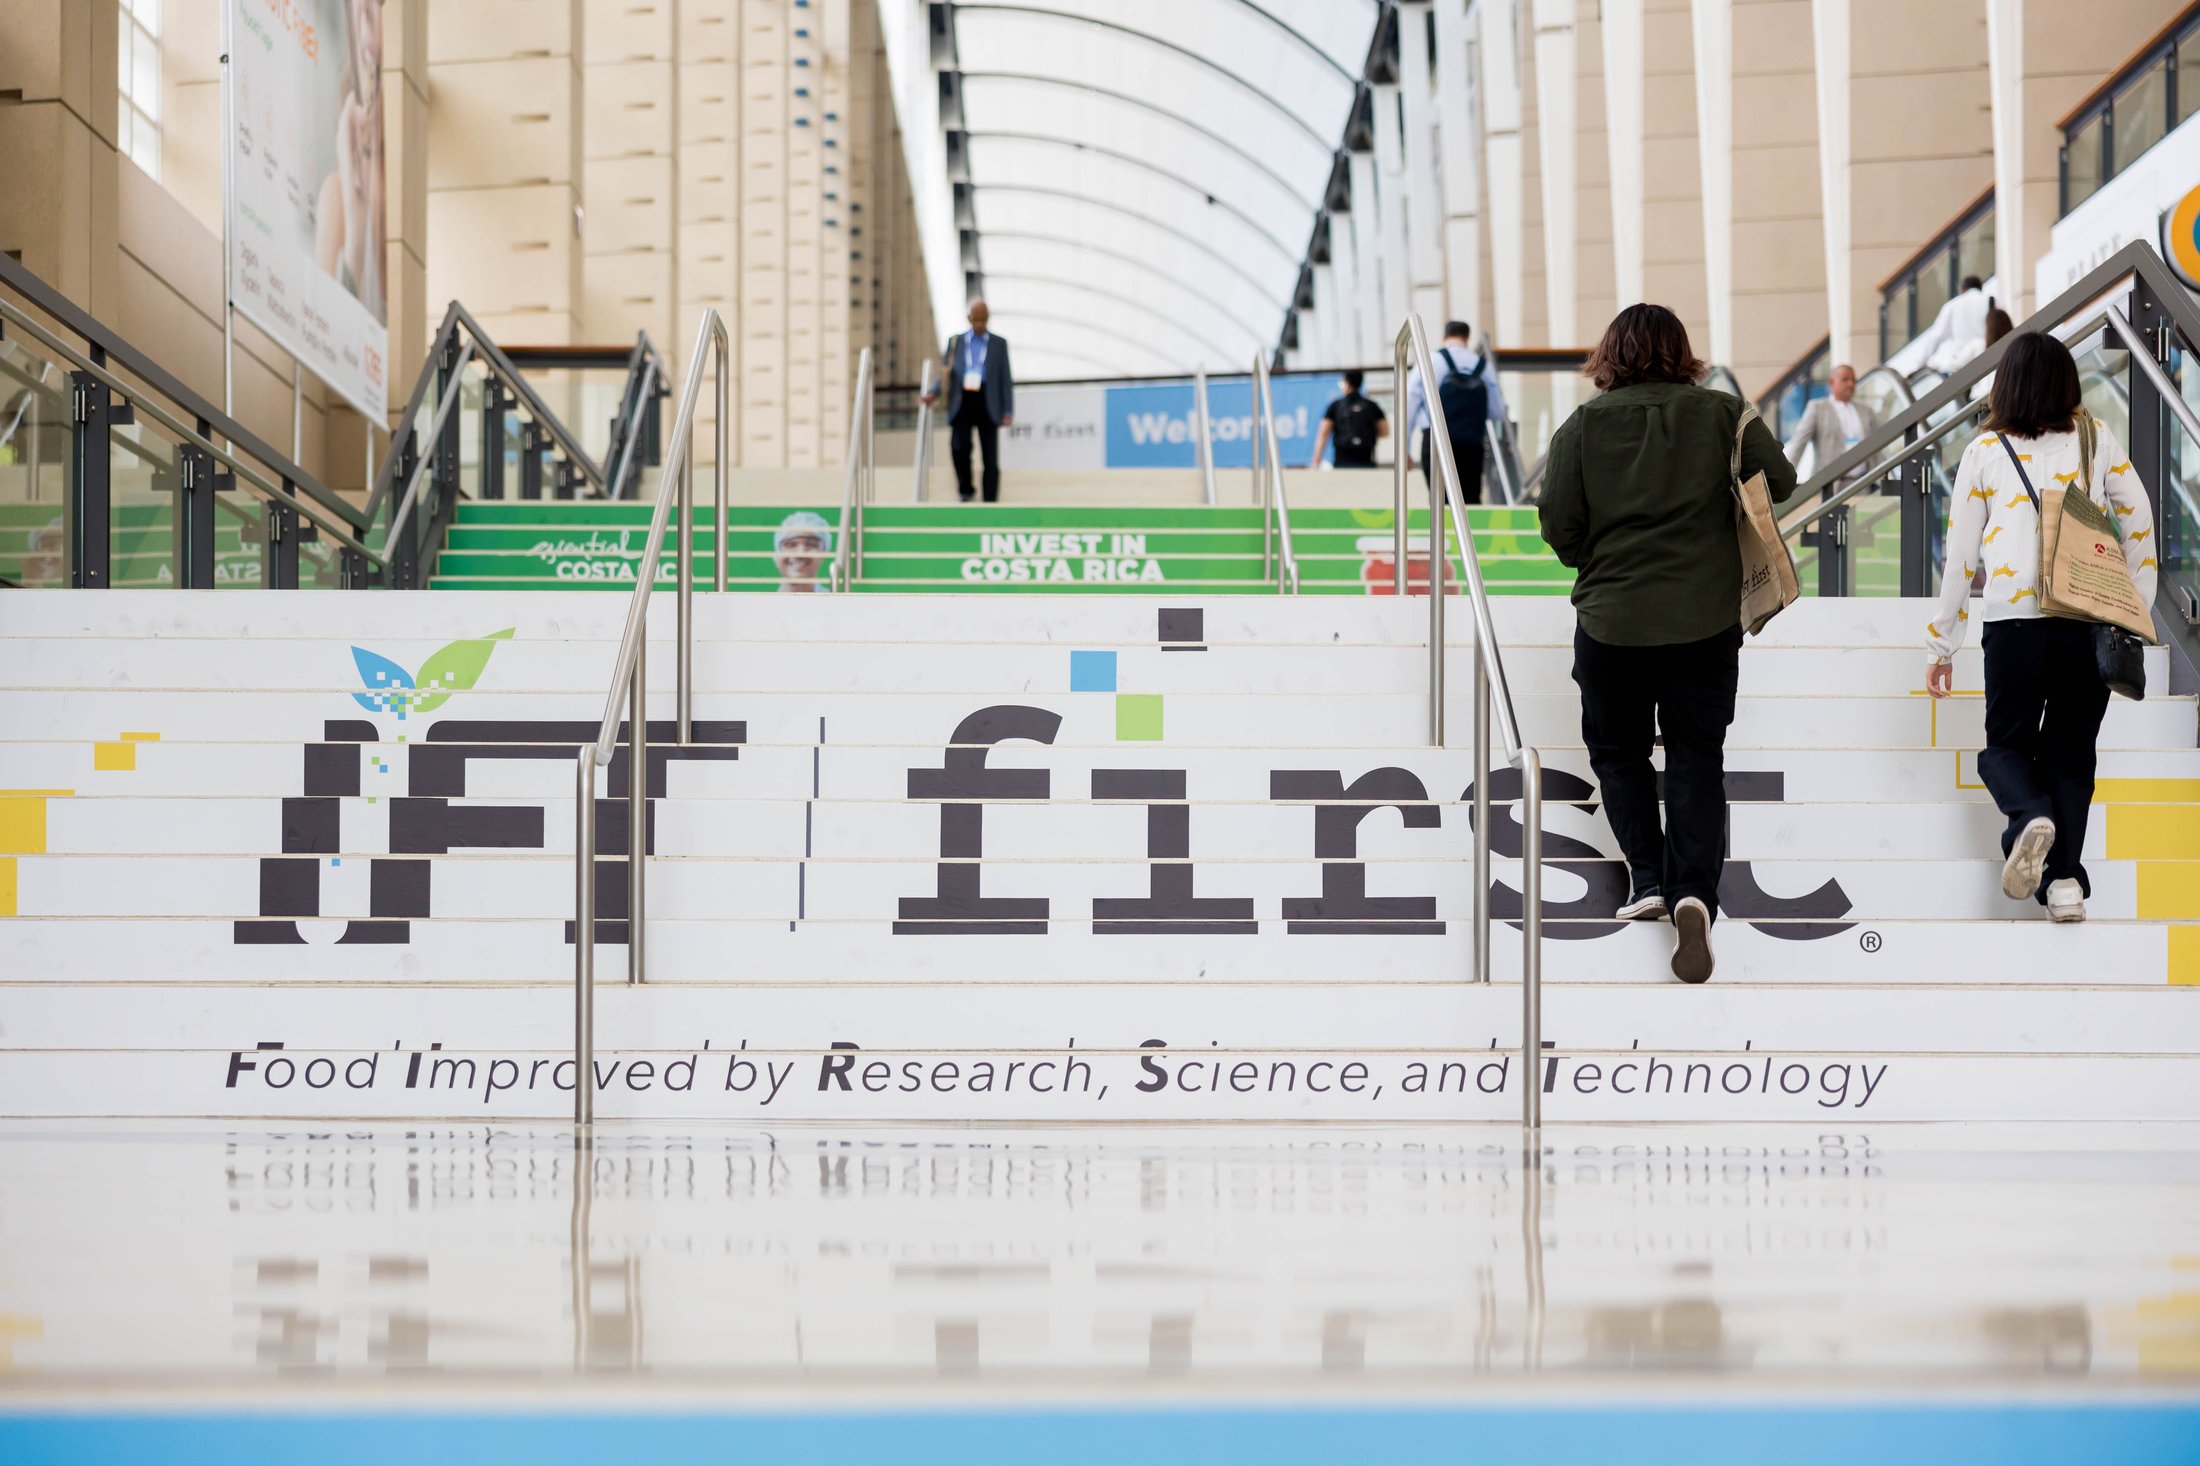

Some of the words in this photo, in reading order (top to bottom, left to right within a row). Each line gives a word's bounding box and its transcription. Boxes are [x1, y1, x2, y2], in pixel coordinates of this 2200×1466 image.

[1128, 406, 1308, 445] Welome!
[980, 534, 1103, 556] INVEST
[1111, 534, 1146, 556] IN
[556, 561, 635, 578] COSTA
[961, 558, 1075, 581] COSTA
[1083, 558, 1165, 581] RICA
[225, 1040, 400, 1088] Food
[405, 1040, 710, 1104] Improved
[724, 1040, 794, 1105] by
[817, 1038, 1110, 1100] Research,
[1134, 1039, 1383, 1100] Science,
[1401, 1038, 1510, 1093] and
[1522, 1040, 1888, 1108] Technology
